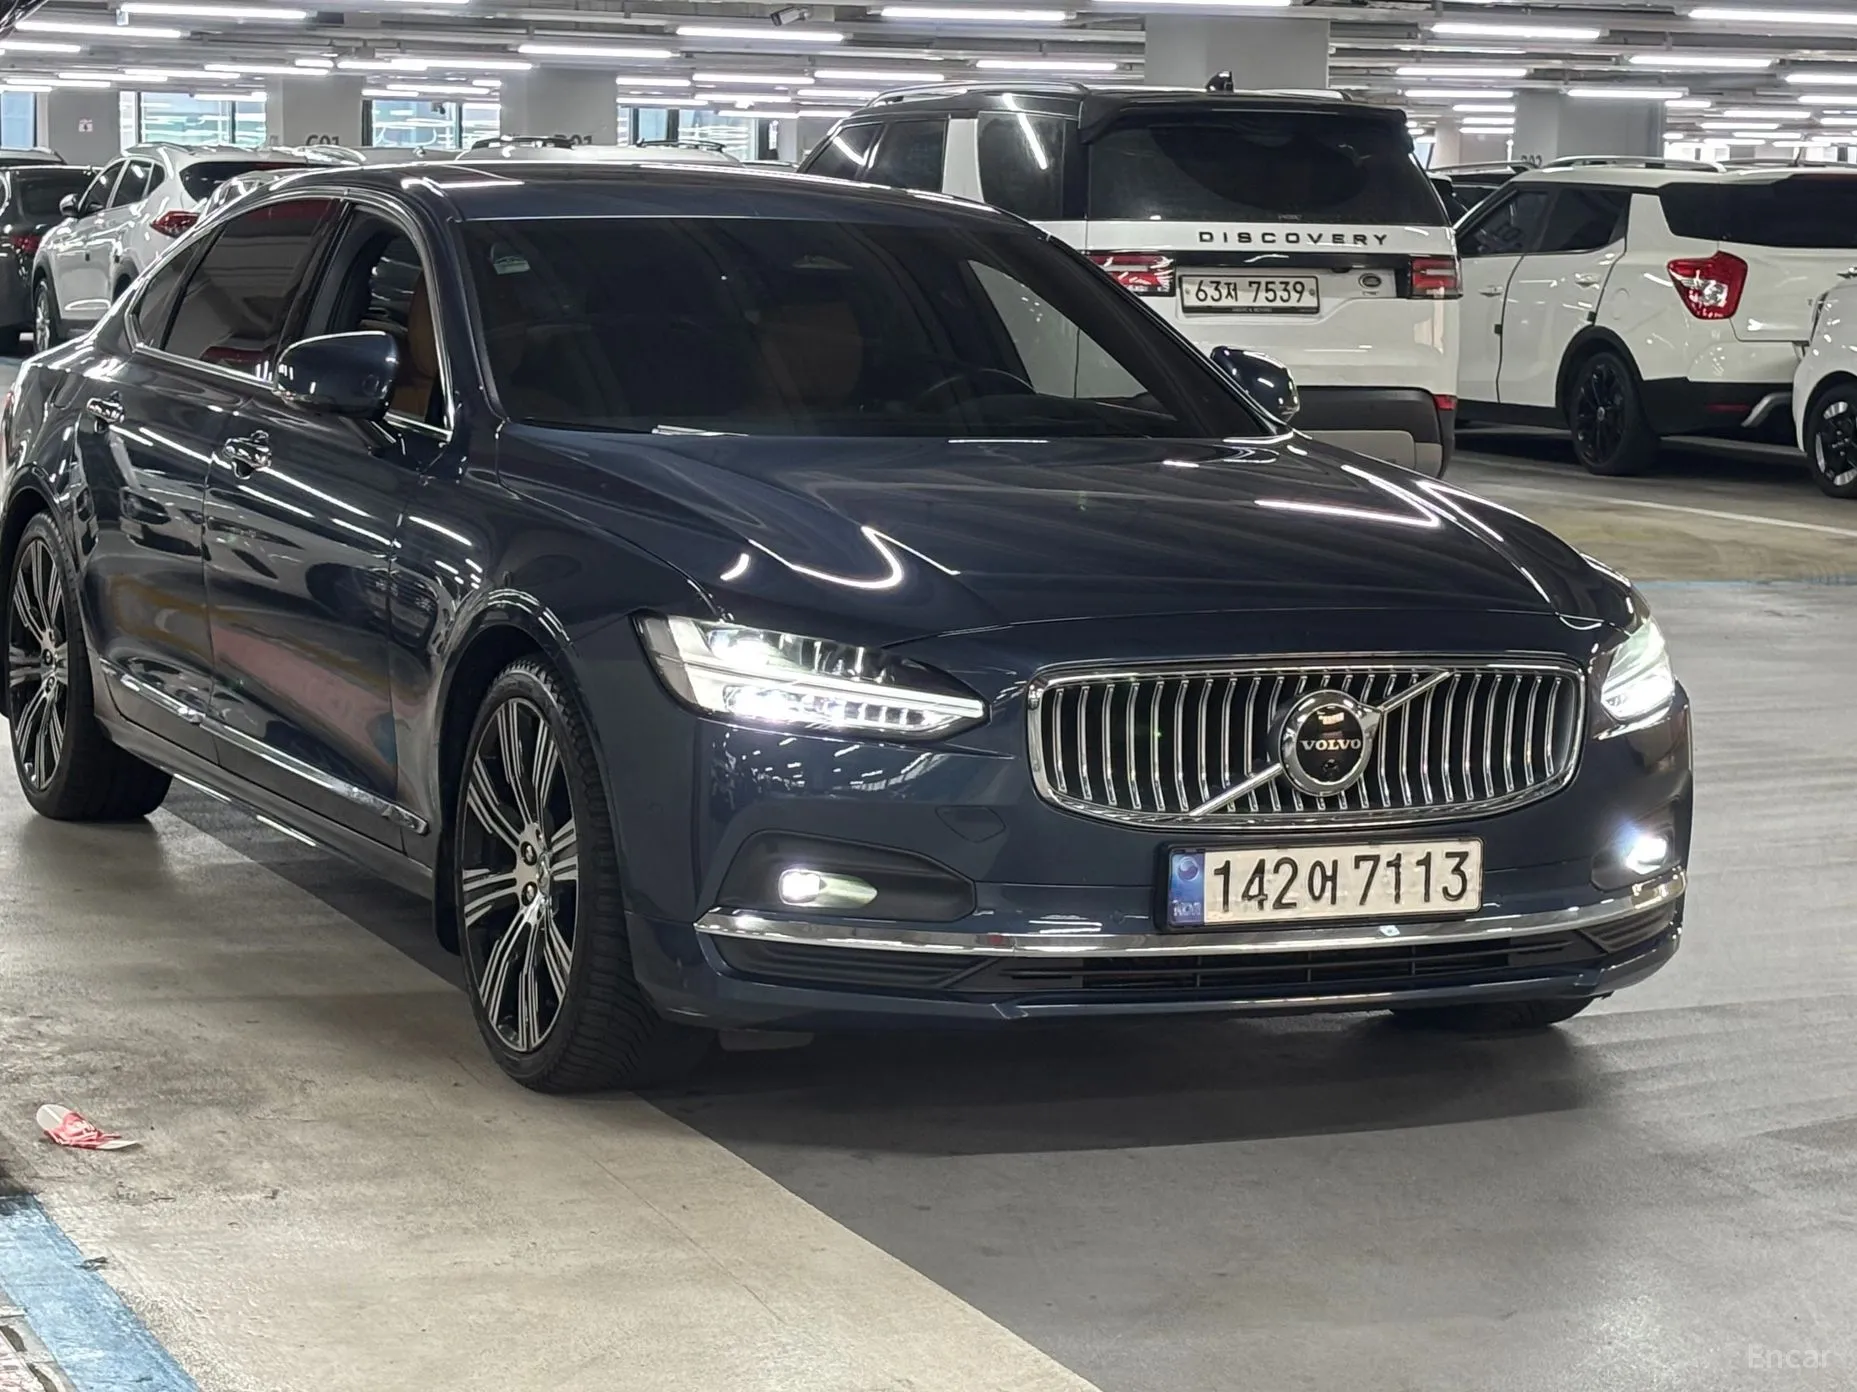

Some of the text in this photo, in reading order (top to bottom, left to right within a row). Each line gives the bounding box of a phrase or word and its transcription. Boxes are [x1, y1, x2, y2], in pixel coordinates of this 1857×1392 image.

[1199, 231, 1388, 246] DISCOVERY
[1195, 281, 1306, 304] 63저 7539
[1301, 739, 1362, 751] VOLVO
[1213, 851, 1470, 913] 142어 7113
